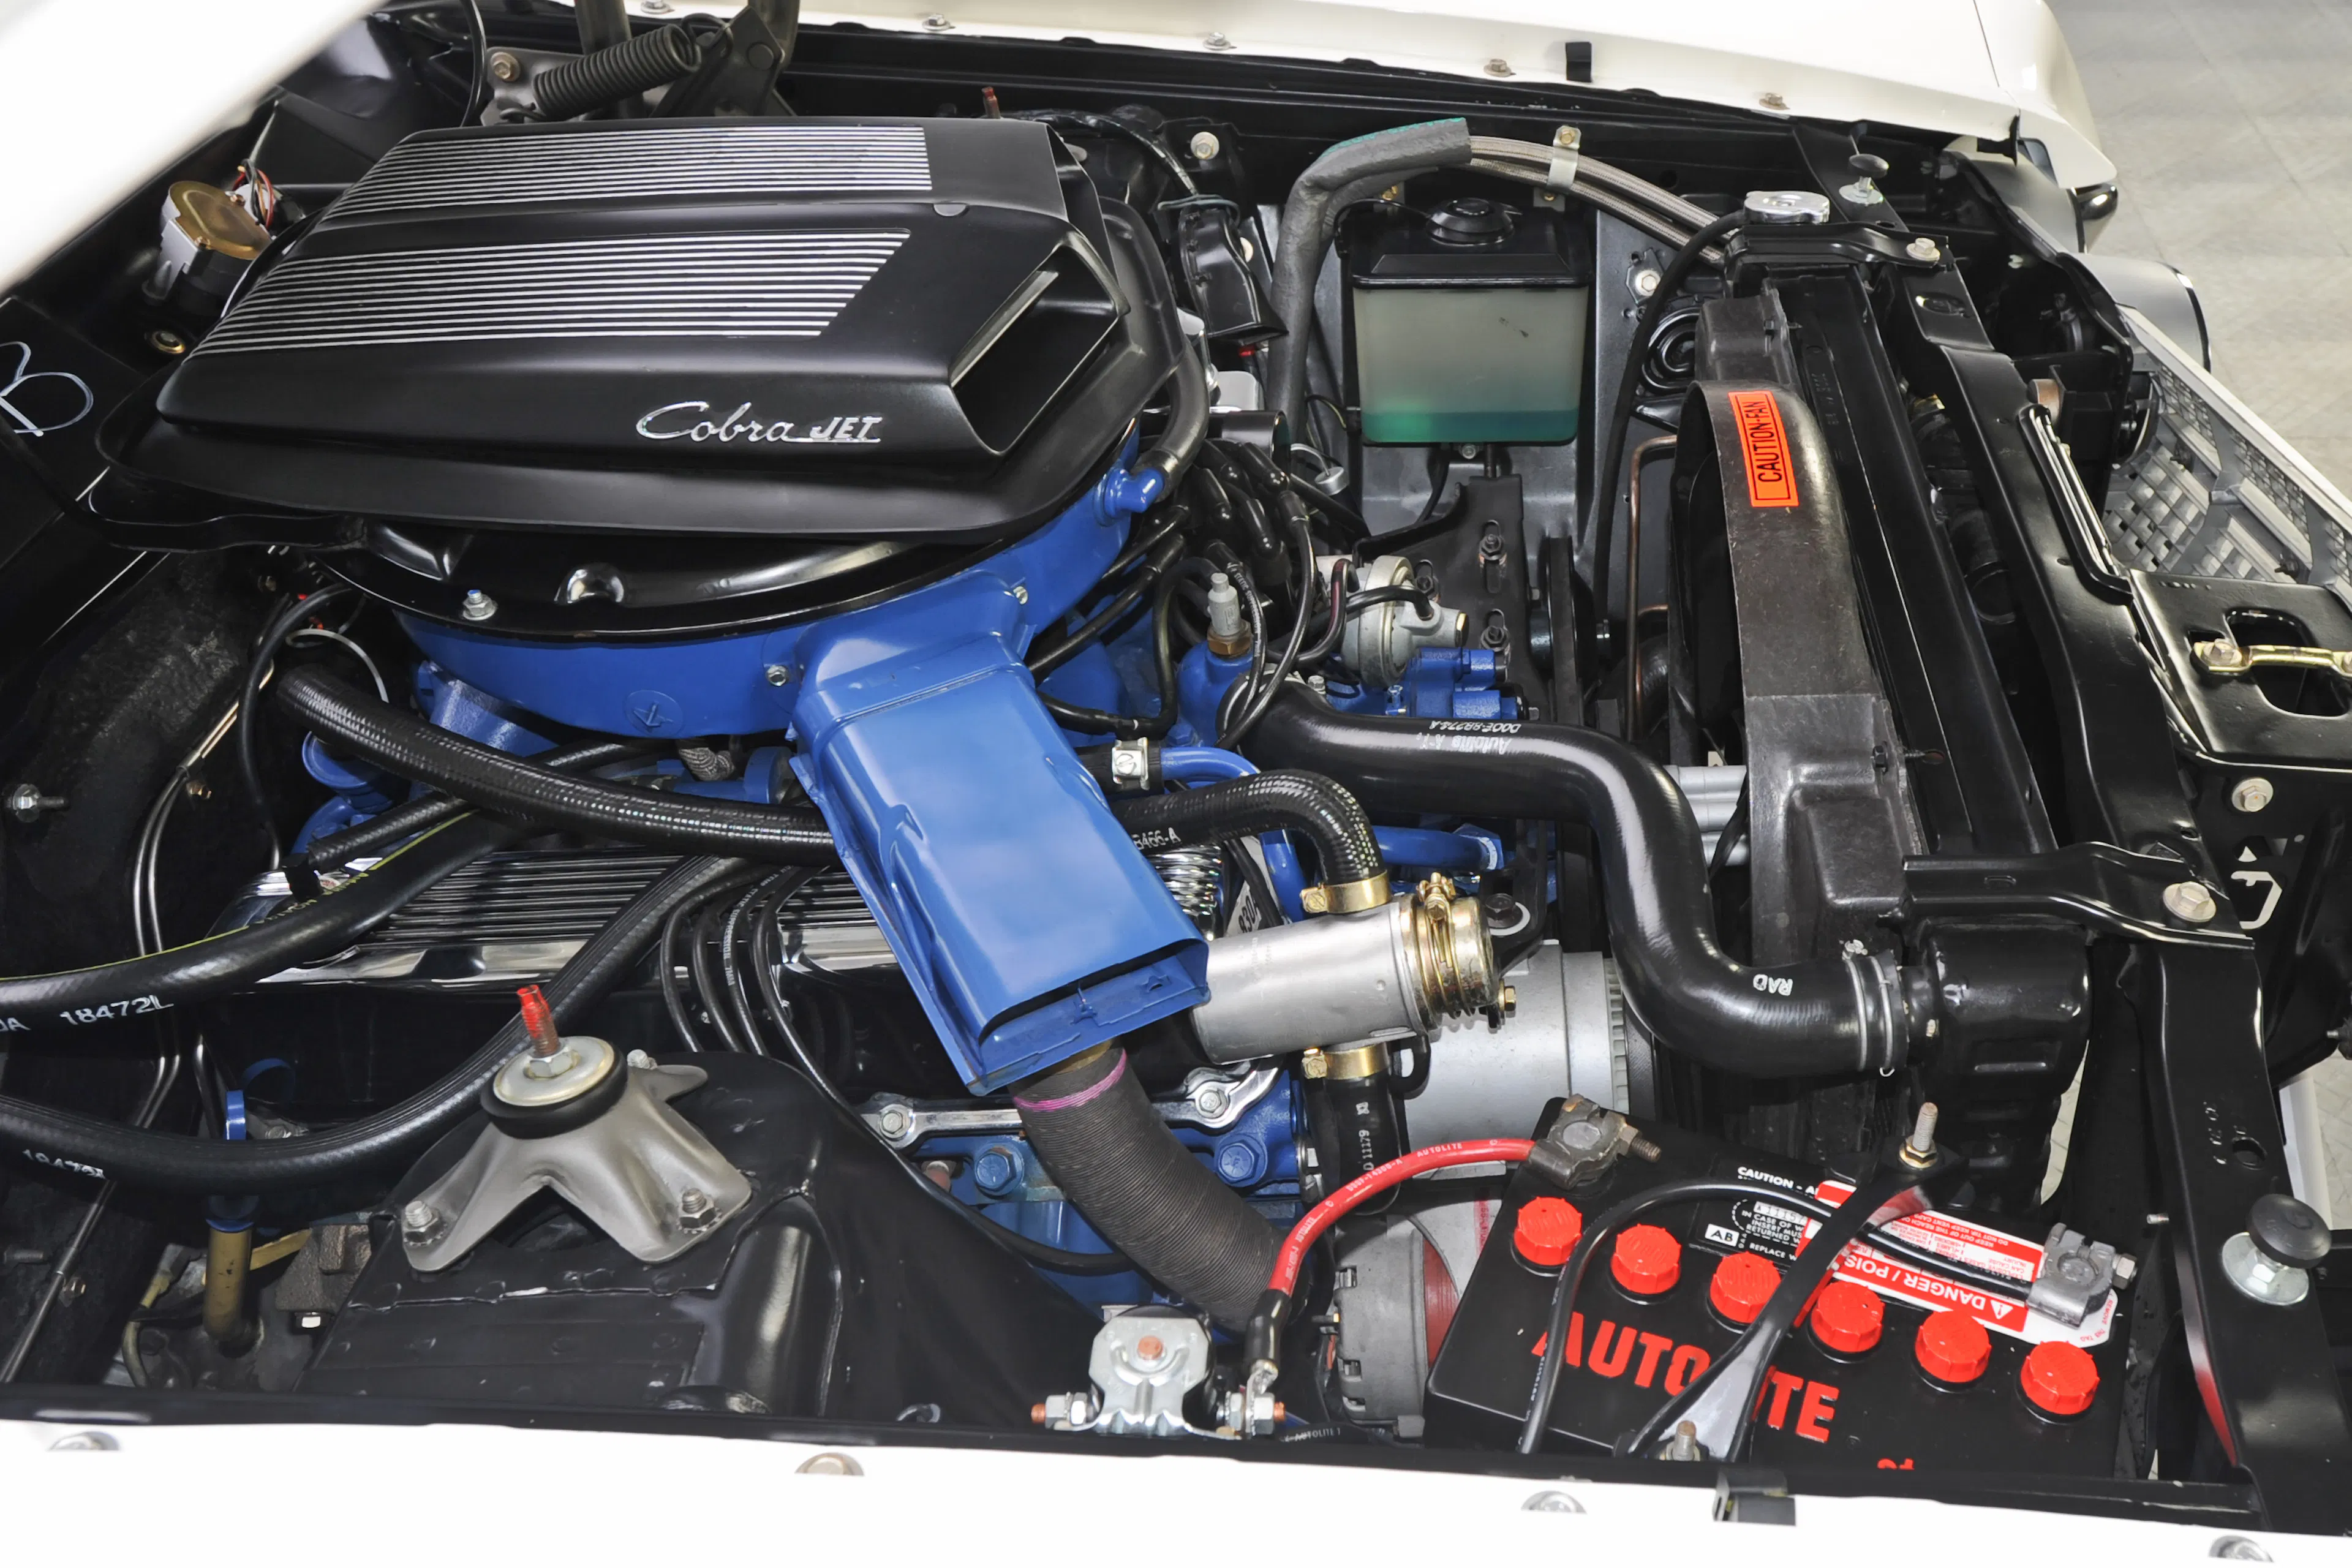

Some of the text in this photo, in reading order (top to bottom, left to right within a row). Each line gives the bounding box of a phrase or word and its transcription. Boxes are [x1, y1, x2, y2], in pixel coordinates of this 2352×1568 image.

[636, 401, 883, 442] Cobra JET
[1752, 974, 1793, 996] RAD
[1417, 1142, 1463, 1158] AUTOLITE
[1738, 1166, 1794, 1189] CAUTION
[1741, 1210, 1752, 1218] IN
[1754, 1213, 1776, 1226] CASE
[1751, 1219, 1782, 1233] INSERT
[1710, 1229, 1733, 1242] AB
[1746, 1224, 1790, 1241] RETURNED
[1959, 1234, 1975, 1242] OUT
[1975, 1238, 1994, 1248] KEEP
[1997, 1238, 2009, 1246] DO
[1749, 1242, 1786, 1259] REPLACE
[1903, 1272, 1986, 1310] DANGER
